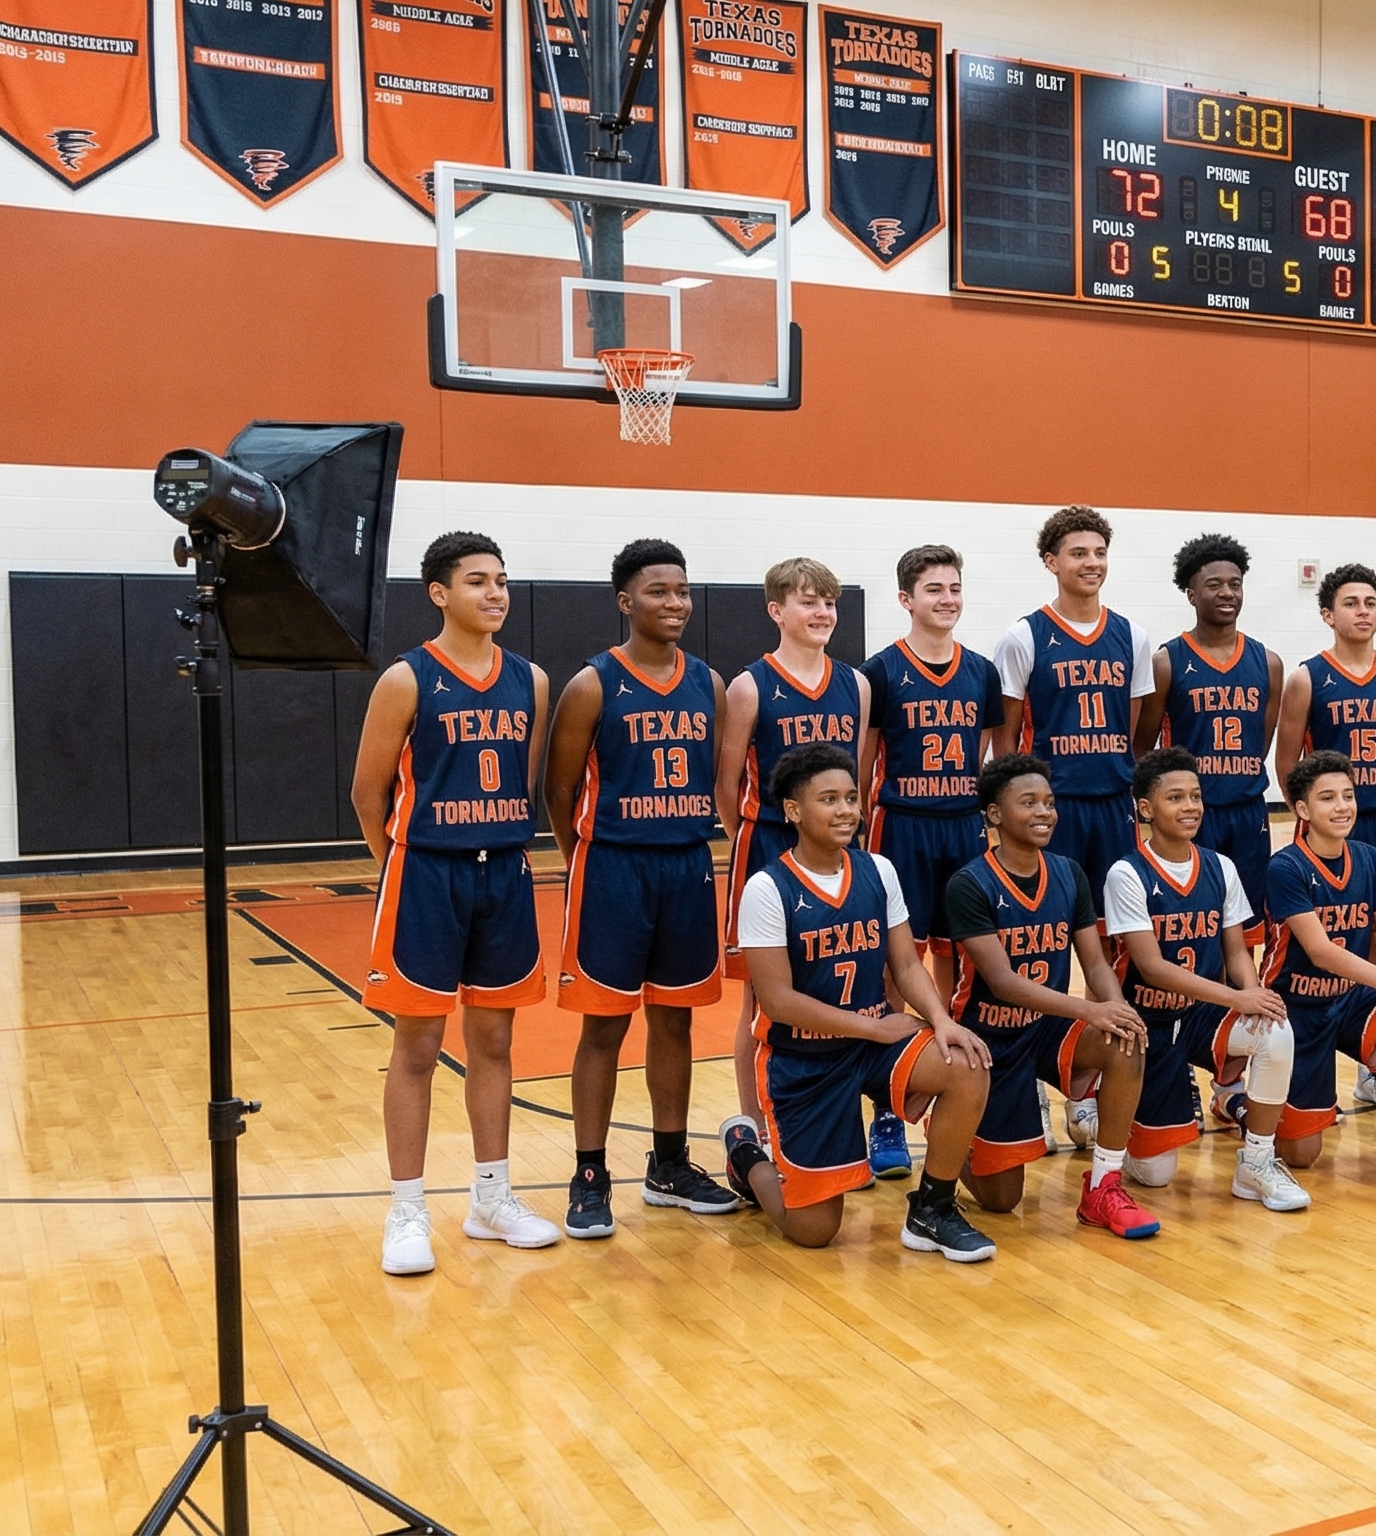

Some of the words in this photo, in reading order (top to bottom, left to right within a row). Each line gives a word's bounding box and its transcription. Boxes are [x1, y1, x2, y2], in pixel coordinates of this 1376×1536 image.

[704, 0, 782, 27] TEXAS
[689, 16, 797, 58] TORNADOES
[844, 20, 918, 49] TEXAS
[831, 38, 933, 79] TORNADOES
[1197, 98, 1283, 151] 0:08
[1102, 138, 1157, 167] HOME
[1112, 169, 1161, 217] 72
[1294, 165, 1350, 193] GUEST
[1219, 188, 1239, 222] 4
[1305, 195, 1352, 241] 68
[1110, 241, 1130, 275] 0
[1152, 246, 1171, 279] 5
[1283, 261, 1301, 293] 5
[1334, 266, 1351, 298] 0
[1052, 659, 1125, 688] TEXAS
[902, 699, 978, 729] TEXAS
[1078, 691, 1107, 728] 11
[1188, 686, 1260, 713] TEXAS
[438, 709, 529, 745] TEXAS
[622, 710, 707, 744] TEXAS
[777, 713, 855, 747] TEXAS
[1212, 716, 1242, 750] 12
[922, 733, 965, 771] 24
[1050, 734, 1128, 755] TORNADOES
[478, 748, 501, 792] 0
[652, 747, 689, 788] 13
[1195, 756, 1262, 776] ORNADOES
[799, 918, 880, 961] TEXAS
[997, 921, 1068, 956] TEXAS
[1151, 909, 1220, 941] TEXAS
[834, 960, 857, 1006] 7
